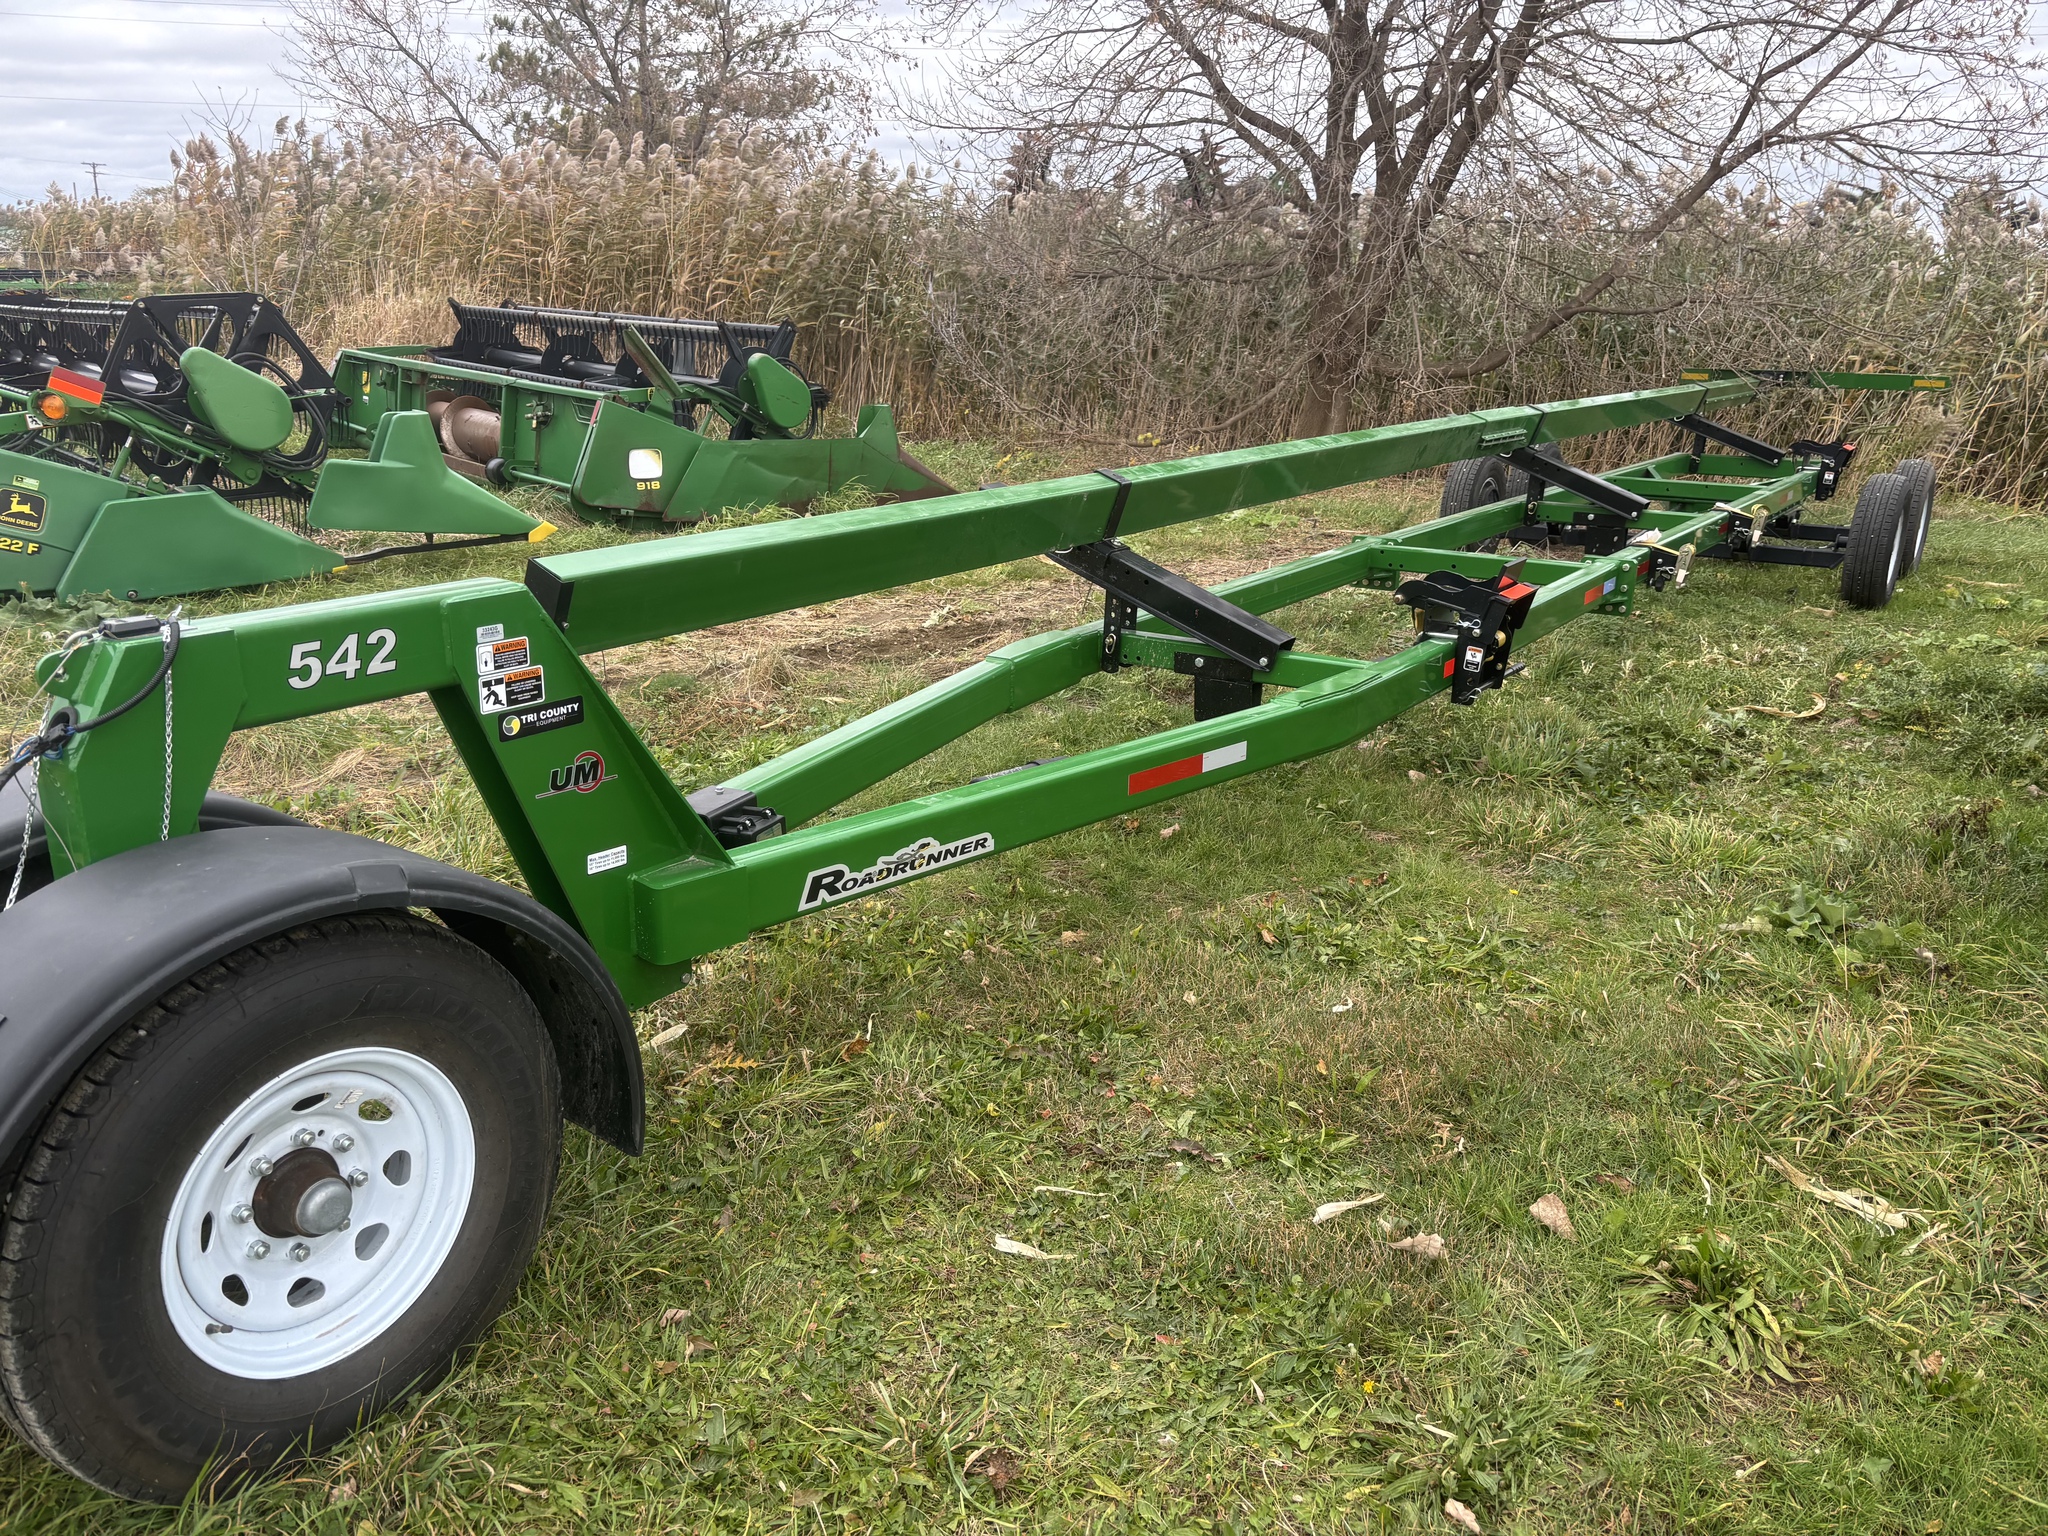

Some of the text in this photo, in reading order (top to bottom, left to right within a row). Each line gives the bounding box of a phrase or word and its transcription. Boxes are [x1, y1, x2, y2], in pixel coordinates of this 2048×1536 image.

[636, 481, 661, 491] 918
[0, 515, 39, 529] OHN DEERE
[0, 537, 40, 555] 22 F
[500, 641, 526, 651] WARNING
[286, 628, 398, 690] 542
[513, 669, 540, 679] WARNING
[520, 703, 580, 724] TRI COUNTY
[536, 715, 566, 727] EQUIPMENT
[549, 758, 601, 792] UM
